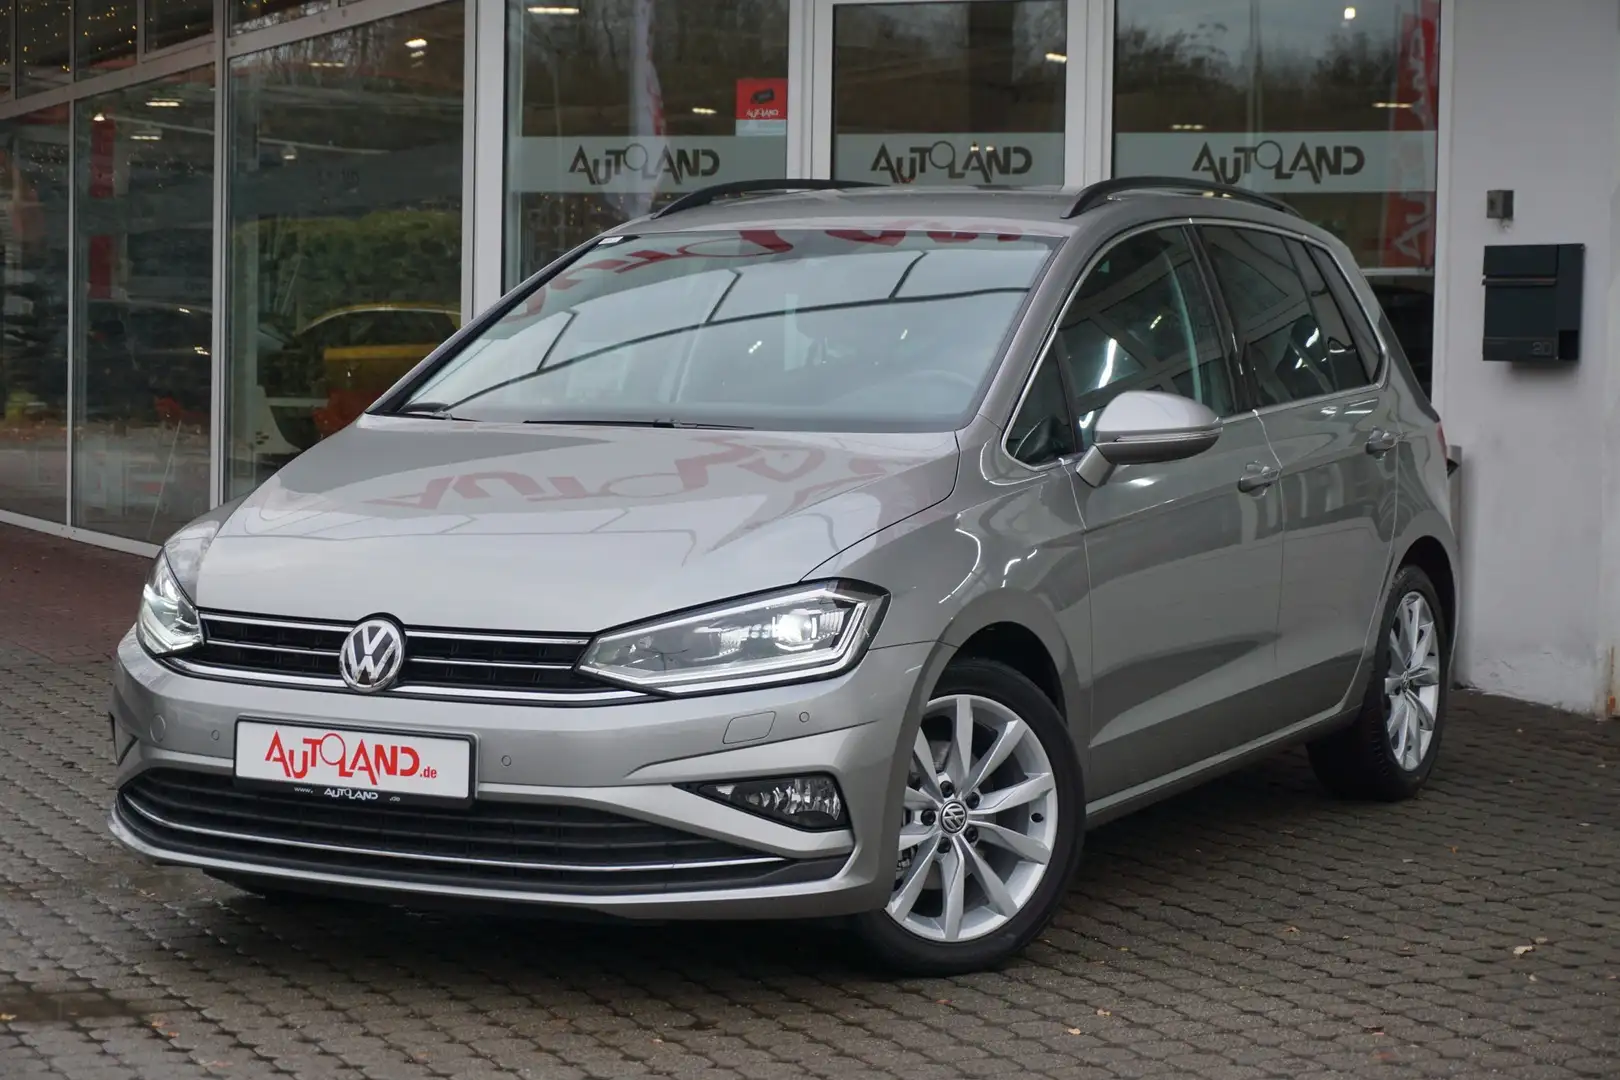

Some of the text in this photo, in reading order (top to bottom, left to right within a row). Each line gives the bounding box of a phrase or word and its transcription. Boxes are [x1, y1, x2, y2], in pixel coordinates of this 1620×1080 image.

[568, 143, 721, 186] AUTOLAND
[870, 140, 1034, 185] AUTOLAND
[1191, 139, 1366, 185] AUTOLAND
[323, 787, 379, 801] AUTOLAND
